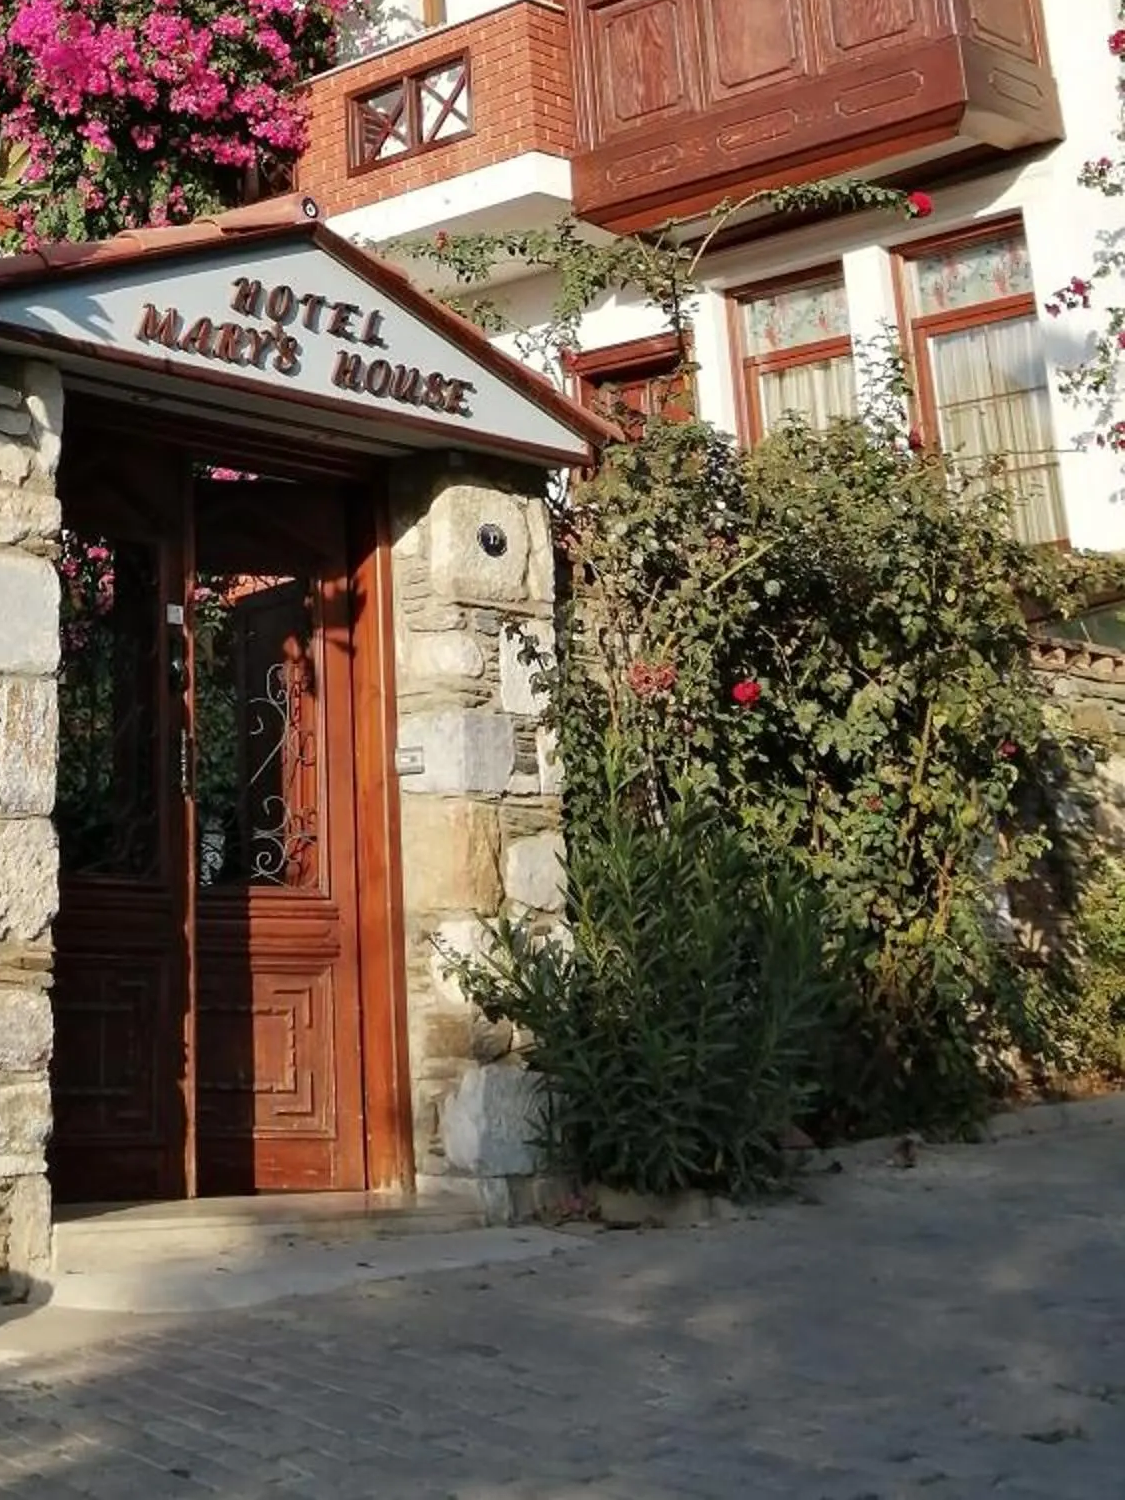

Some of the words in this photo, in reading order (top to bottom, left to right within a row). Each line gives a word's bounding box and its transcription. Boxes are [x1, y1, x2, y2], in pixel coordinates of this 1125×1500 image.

[230, 276, 386, 348] HOTEL
[135, 302, 300, 375] MARY'S
[331, 350, 477, 416] HOUSE
